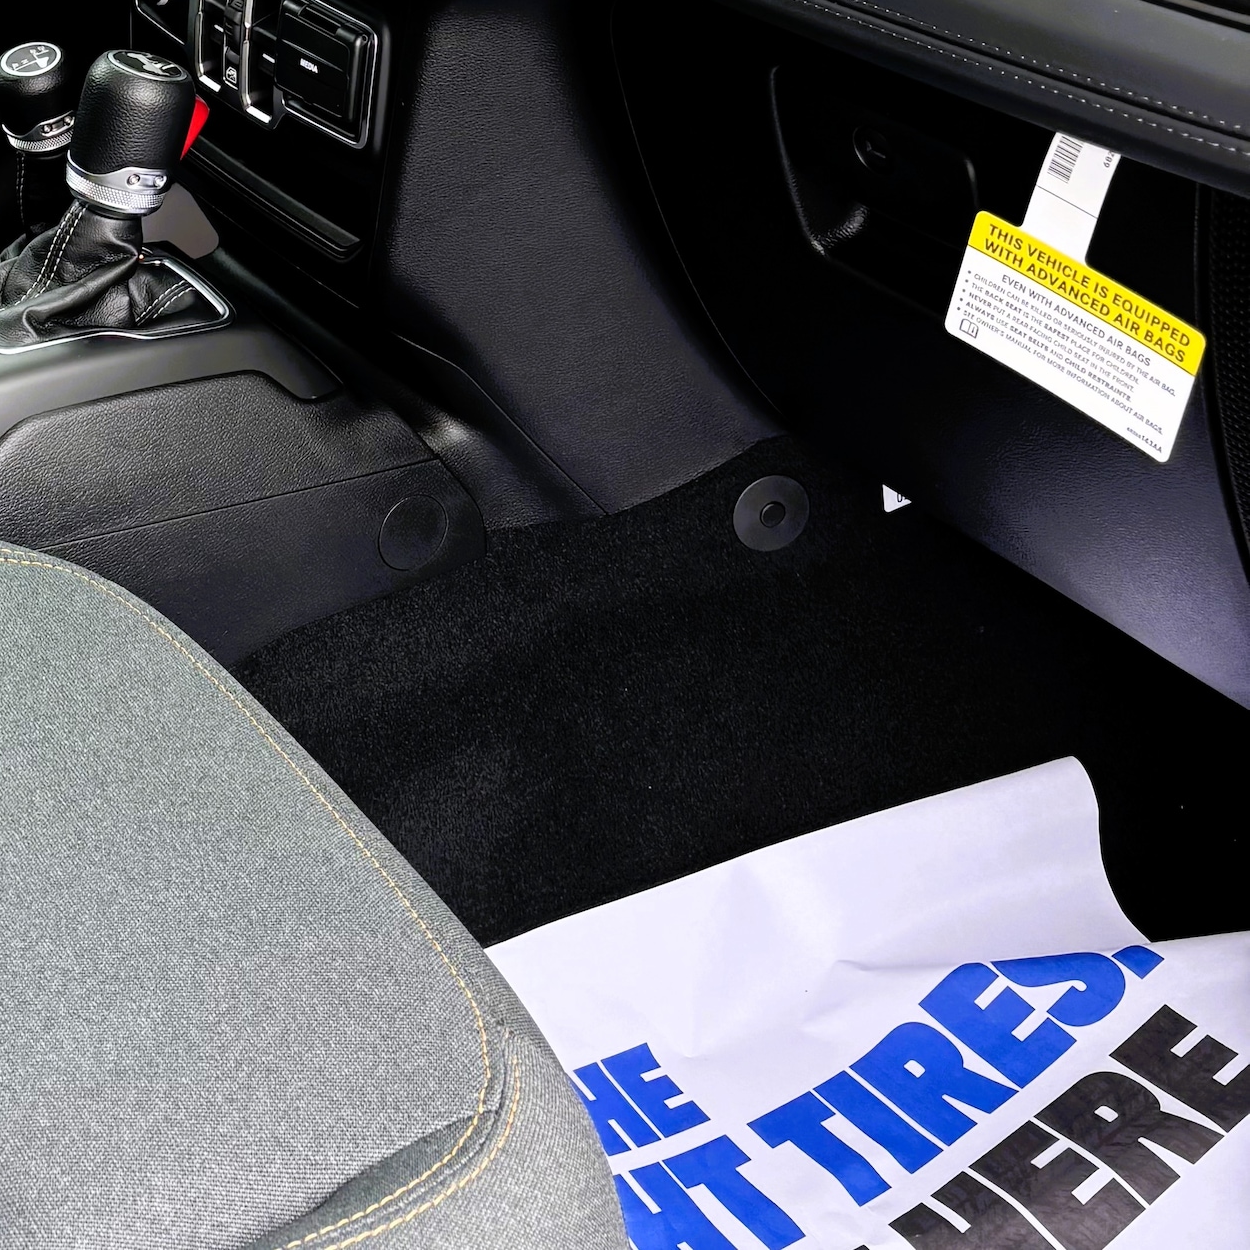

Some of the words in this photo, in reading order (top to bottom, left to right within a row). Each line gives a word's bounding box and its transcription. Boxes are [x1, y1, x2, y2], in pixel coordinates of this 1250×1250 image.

[300, 58, 318, 73] MEDIA
[969, 292, 992, 308] NEVER
[993, 305, 1006, 315] PUT
[1053, 338, 1073, 355] CHILD
[1074, 352, 1090, 364] SEAT
[1099, 366, 1112, 379] THE
[971, 282, 983, 293] THE
[984, 289, 1004, 304] BACK
[1005, 301, 1022, 314] SEAT
[1031, 315, 1043, 326] THE
[1043, 323, 1070, 342] SAFEST
[1070, 338, 1091, 355] PLACE
[1092, 351, 1105, 362] FOR
[974, 273, 1005, 294] CHILDREN
[1006, 291, 1020, 303] CAN
[1021, 299, 1029, 308] BE
[1030, 305, 1051, 320] KILLED
[1053, 316, 1062, 326] OR
[1064, 322, 1098, 347] SERIOUSLY
[1098, 344, 1126, 363] INJURED
[1136, 367, 1149, 378] THE
[1149, 376, 1161, 386] AIR
[985, 238, 1023, 268] WITH
[1026, 263, 1110, 317] ADVANCED
[1113, 313, 1140, 336] AIR
[1143, 329, 1186, 363] BAGS
[990, 224, 1023, 250] THIS
[1027, 243, 1090, 289] VEHICLE
[1093, 282, 1109, 299] IS
[1112, 293, 1190, 347] EQUIPPED
[1001, 274, 1026, 293] EVEN
[1028, 288, 1053, 309] WITH
[1053, 304, 1105, 339] ADVANCED
[1106, 336, 1124, 349] AIR
[1125, 345, 1151, 367] BAGS
[963, 309, 975, 321] SEE
[1005, 333, 1031, 353] MANUAL
[1032, 350, 1047, 362] FOR
[1047, 358, 1065, 373] MORE
[1066, 369, 1110, 400] INFORMATION
[1110, 397, 1133, 414] ABOUT
[1133, 410, 1145, 422] AIR
[966, 302, 995, 321] ALWAYS
[996, 317, 1009, 329] USE
[1010, 325, 1027, 339] SEAT
[1028, 336, 1049, 352] BELTS
[1050, 348, 1064, 361] AND
[1064, 357, 1086, 374] CHILD
[746, 945, 1165, 1207] TIRES.
